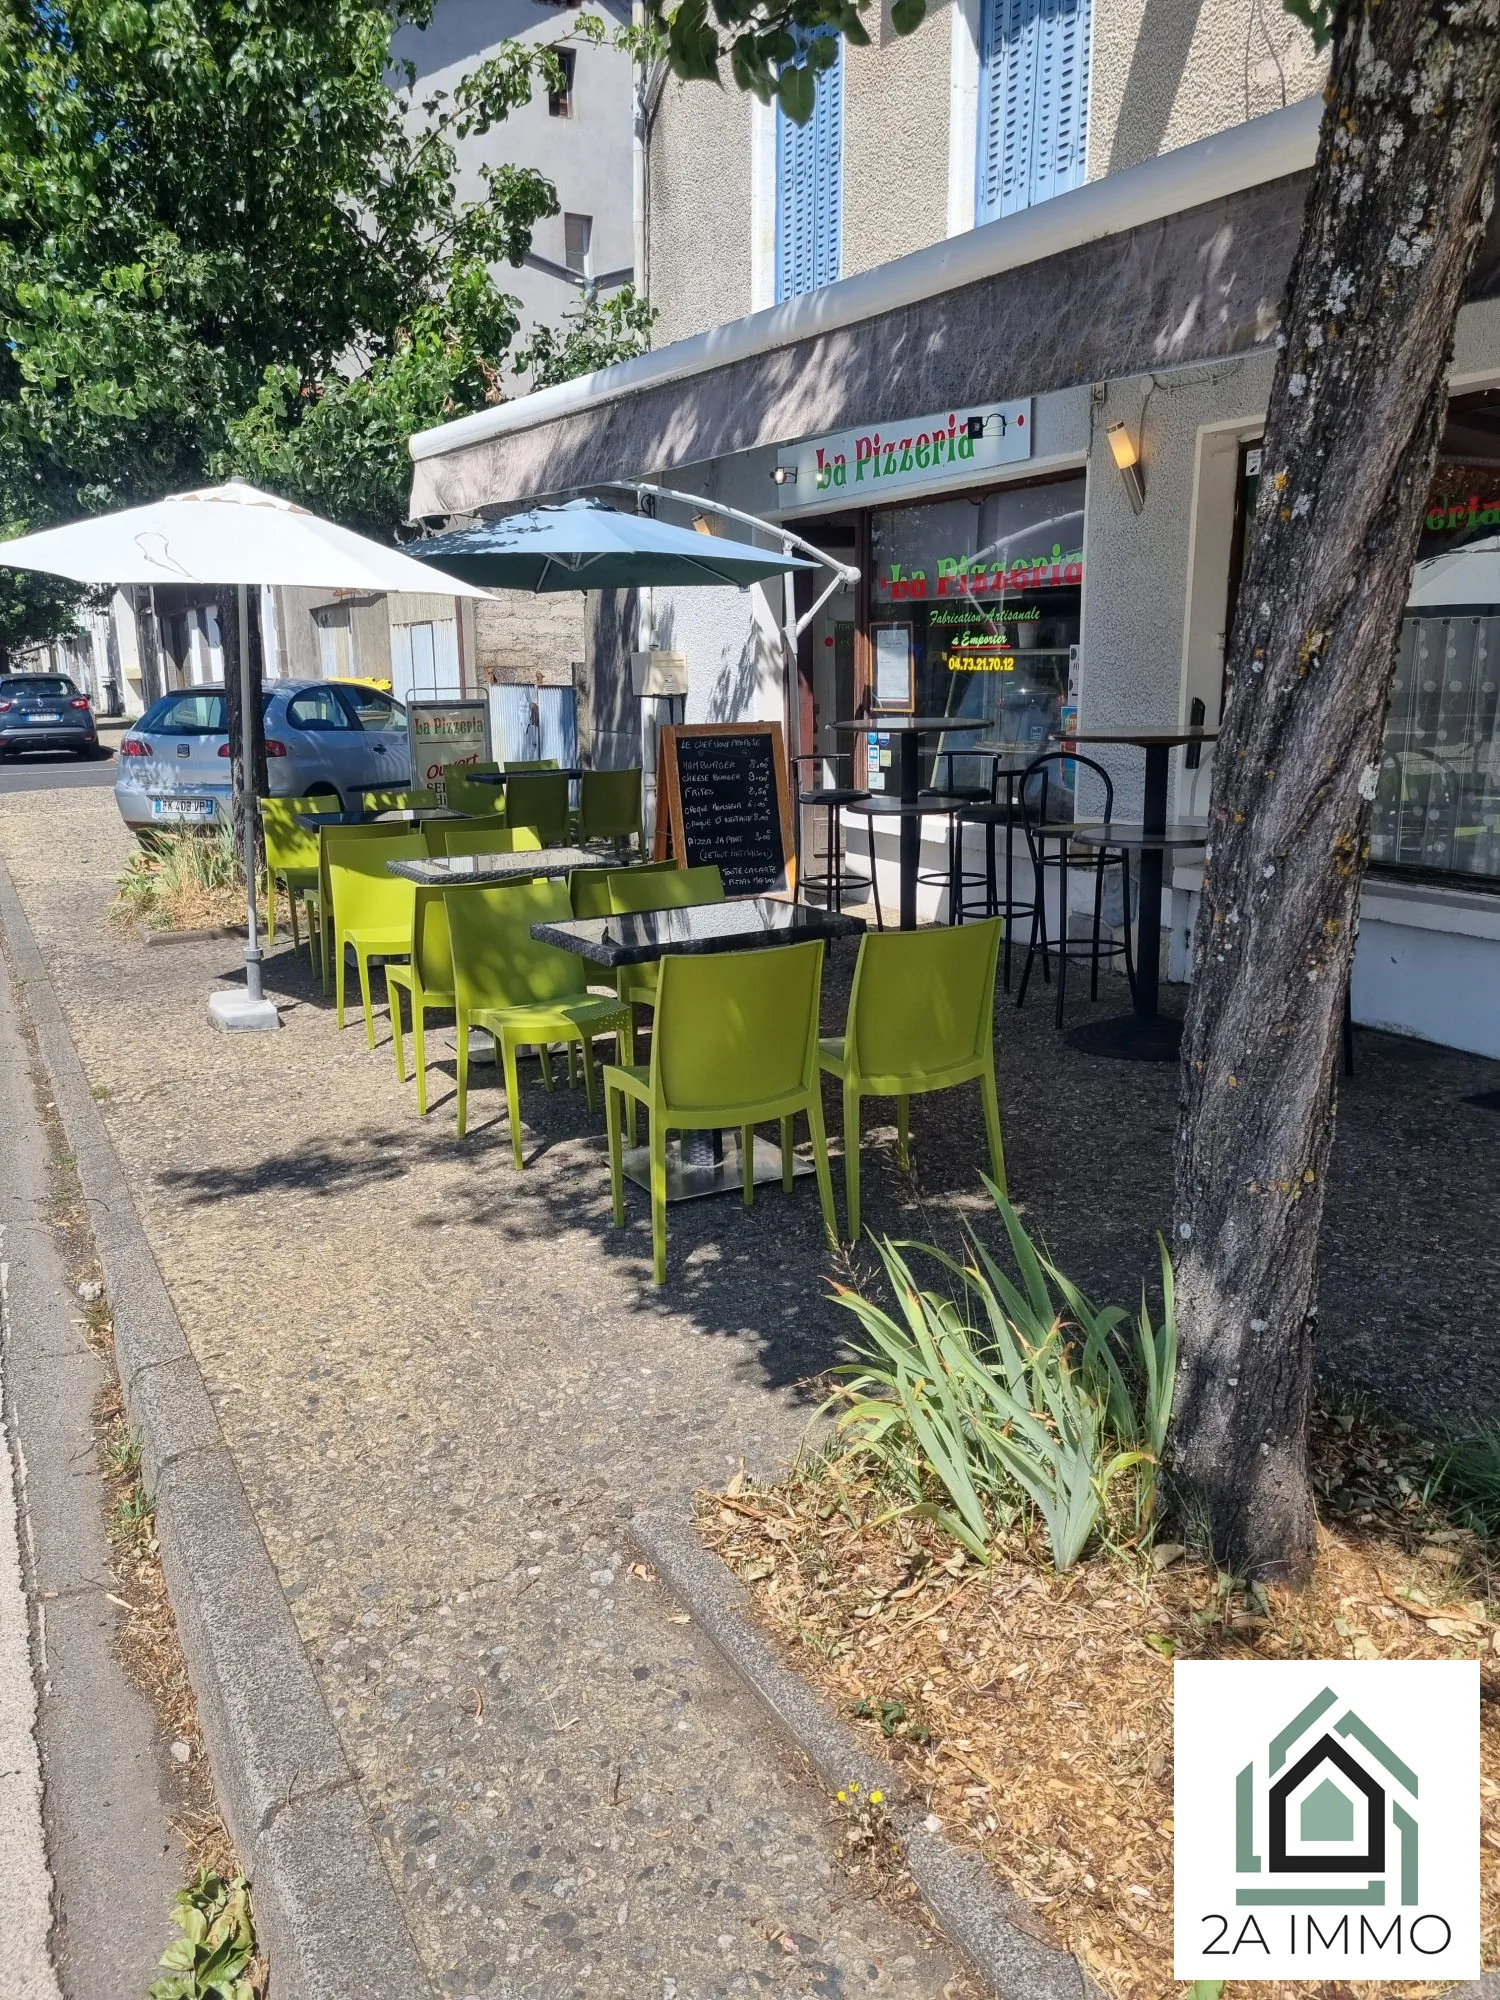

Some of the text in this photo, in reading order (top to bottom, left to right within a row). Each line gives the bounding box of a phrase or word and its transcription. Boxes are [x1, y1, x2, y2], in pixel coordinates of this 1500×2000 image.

[815, 412, 975, 491] La Pizzeria
[890, 544, 1084, 599] La Pizzeria
[929, 605, 1041, 626] Fabrication Artisanale
[960, 630, 1008, 647] Emporter
[948, 656, 1014, 671] 04.73.21.70.12
[414, 715, 484, 735] La Pizzeria
